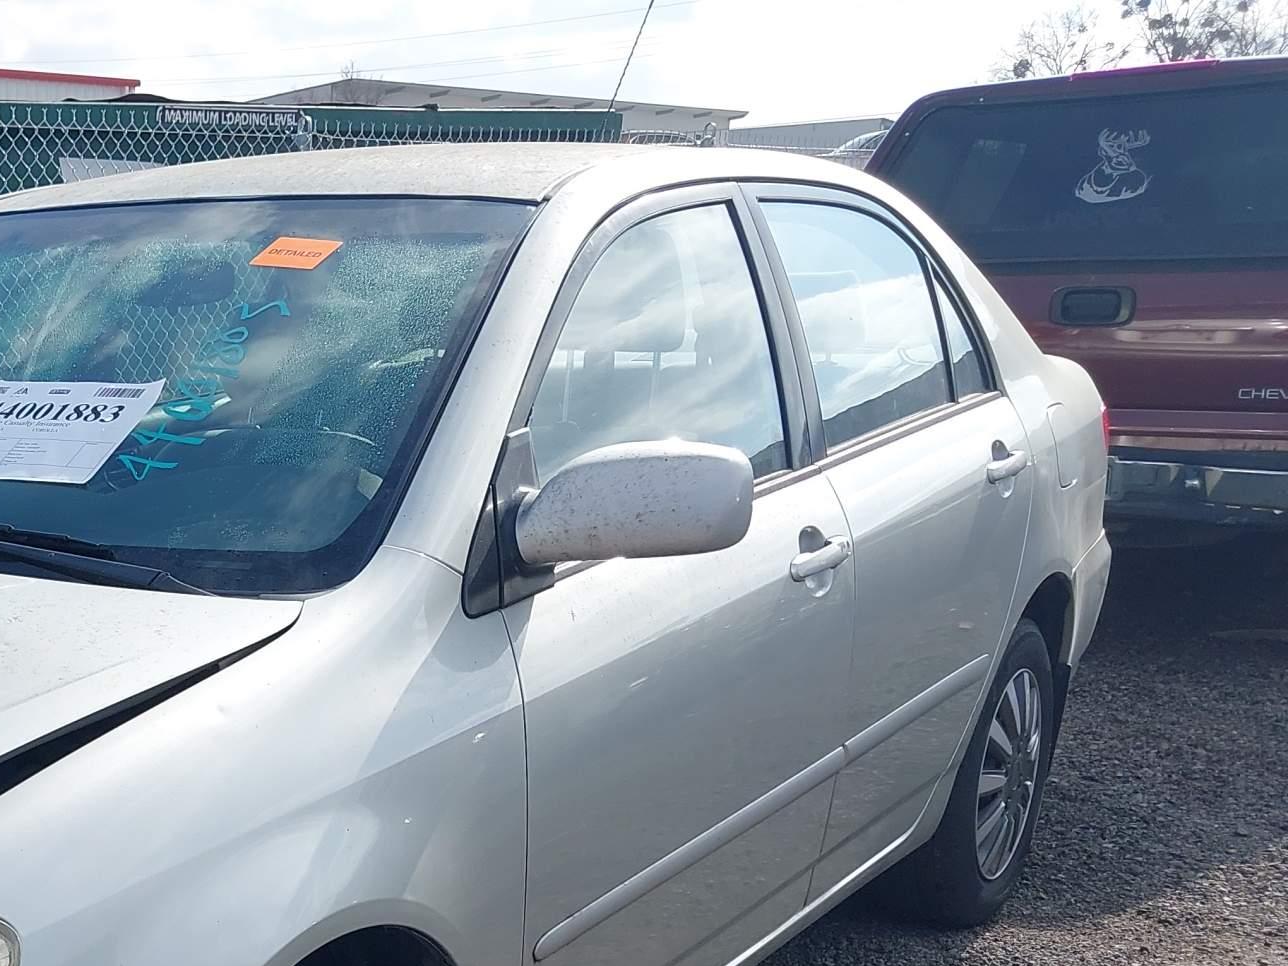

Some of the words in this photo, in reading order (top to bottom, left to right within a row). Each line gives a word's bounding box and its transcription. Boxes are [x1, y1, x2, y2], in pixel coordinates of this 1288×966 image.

[164, 109, 219, 124] MAXIMUM
[221, 112, 268, 127] LOADING
[269, 113, 298, 127] LEVEL
[268, 248, 323, 258] DETAILED
